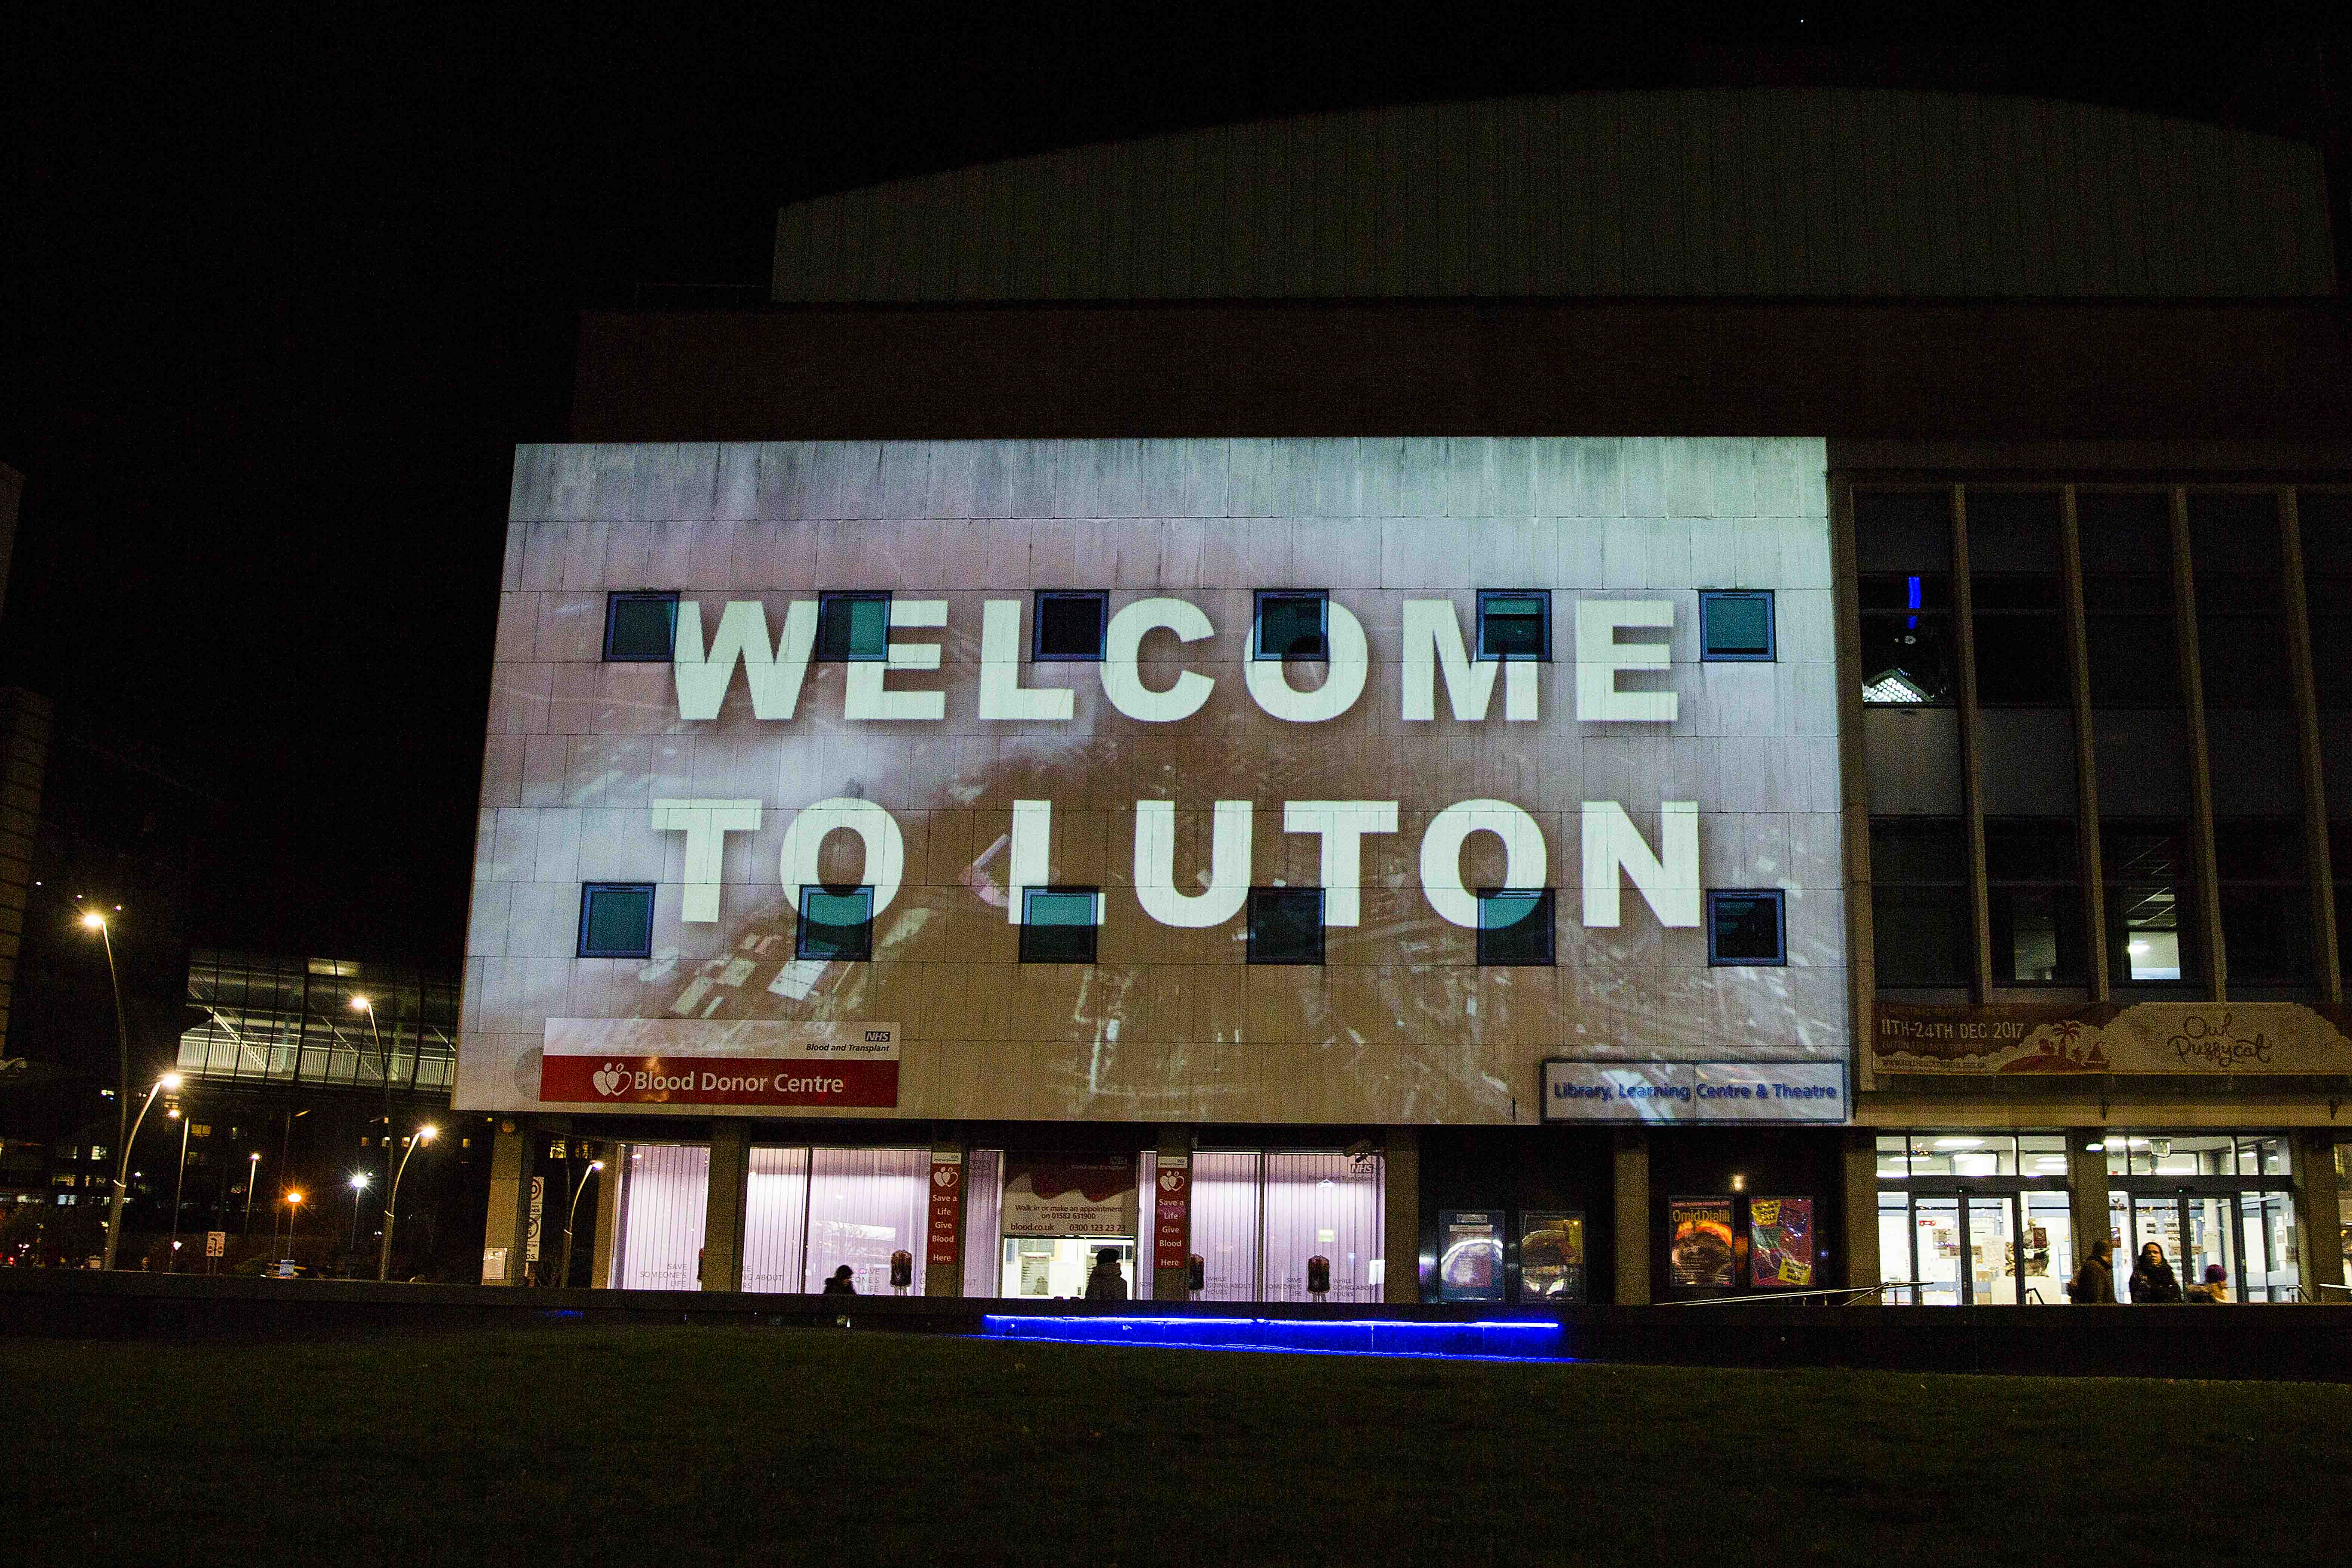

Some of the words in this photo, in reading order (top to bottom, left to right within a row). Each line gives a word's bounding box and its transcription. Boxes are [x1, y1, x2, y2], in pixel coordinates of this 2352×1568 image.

[676, 597, 1678, 722] WELCOME
[652, 799, 903, 925] TO
[1009, 799, 1701, 928] LUTON
[866, 1032, 890, 1041] NHS
[1960, 1023, 1987, 1038] DEC
[1993, 1022, 2024, 1038] 2017
[849, 1044, 890, 1052] Transplant
[634, 1071, 694, 1091] Blood
[701, 1072, 768, 1091] Donor
[774, 1074, 844, 1093] Centre
[1554, 1082, 1613, 1101] Library,
[1619, 1083, 1690, 1101] Learning
[1696, 1083, 1751, 1098] Centre
[1756, 1083, 1767, 1098] &
[1772, 1083, 1836, 1098] Theatre
[1351, 1164, 1373, 1173] NHS
